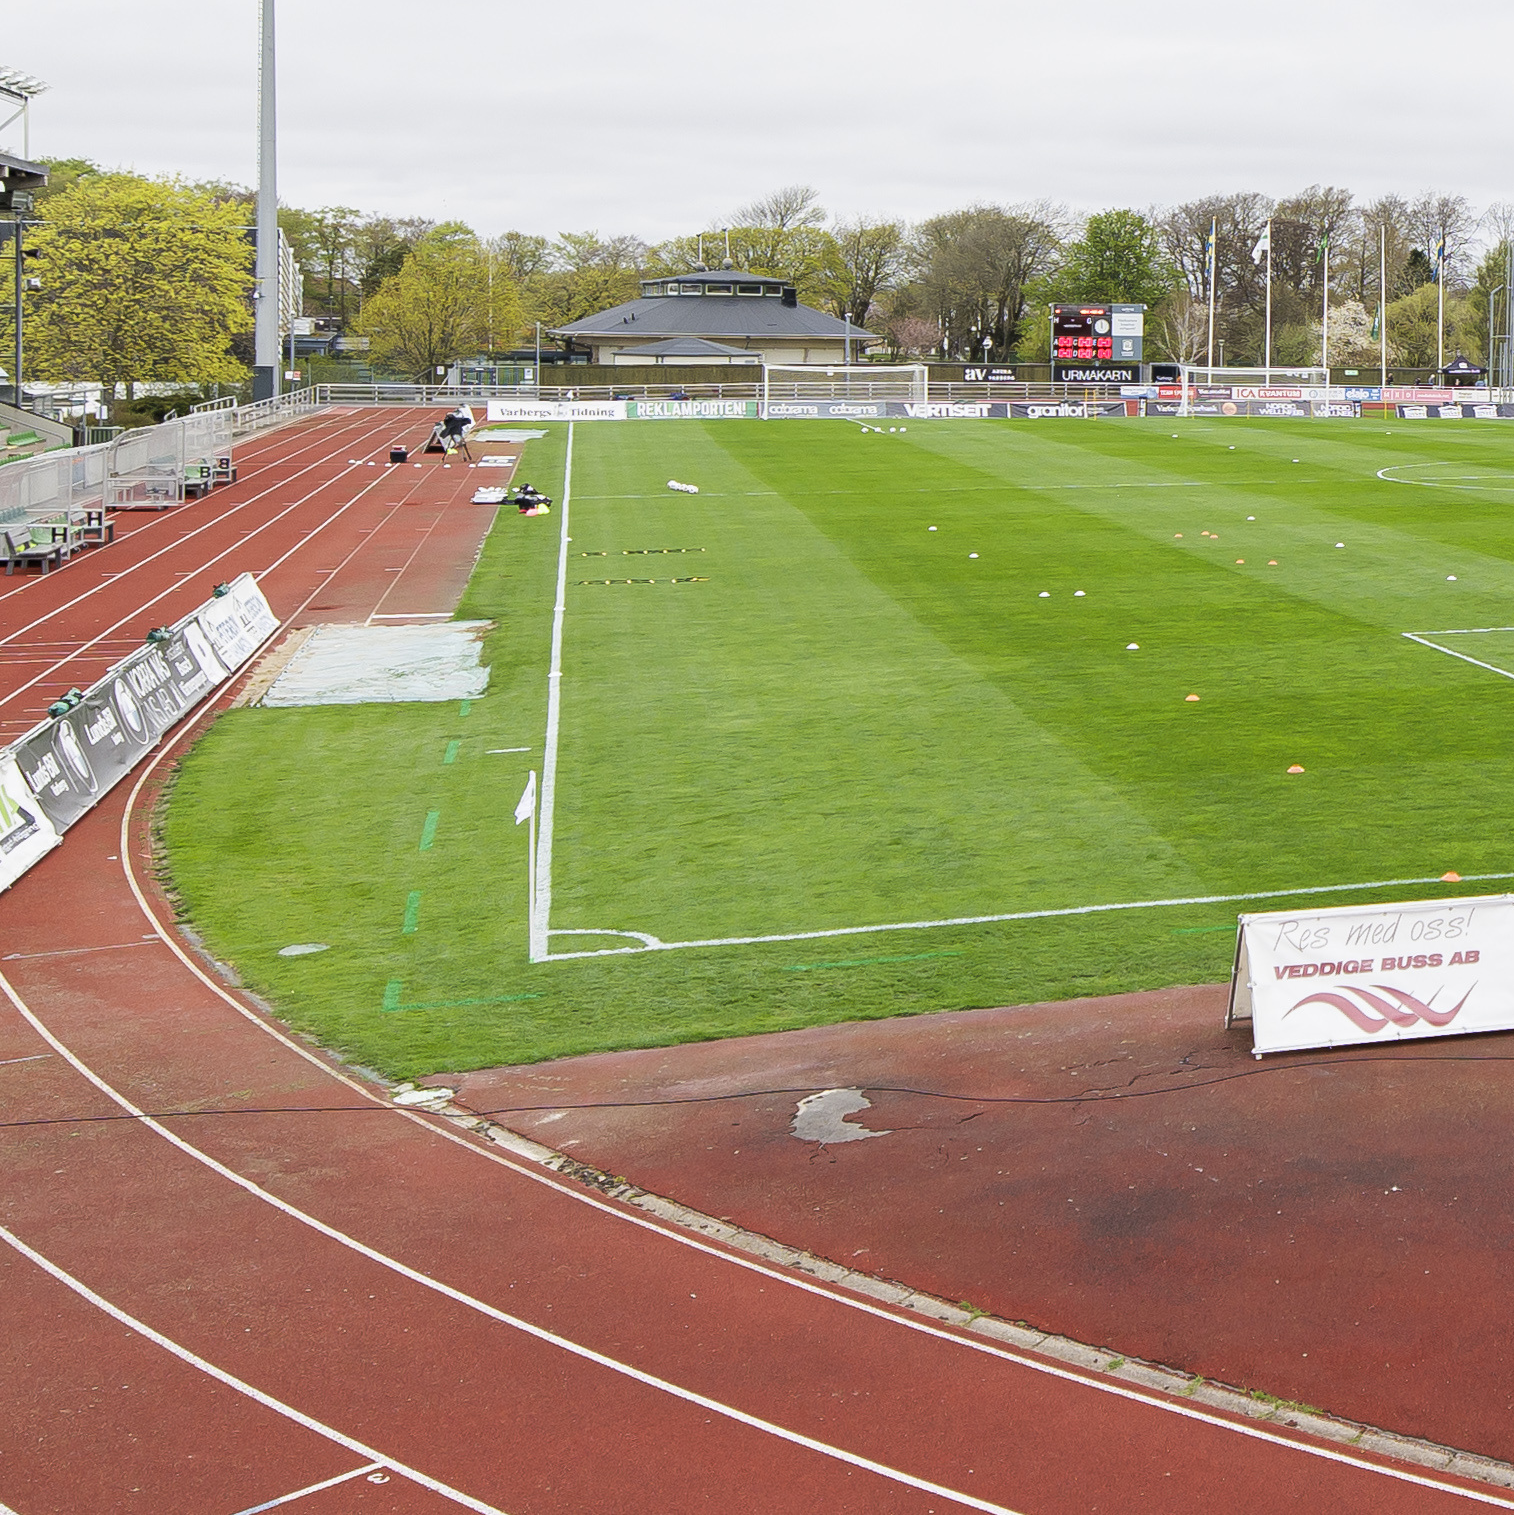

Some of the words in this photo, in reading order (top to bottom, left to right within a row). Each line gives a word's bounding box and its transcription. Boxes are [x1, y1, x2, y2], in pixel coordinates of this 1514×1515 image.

[499, 407, 552, 418] Varbergs
[570, 407, 615, 418] Tidning
[637, 401, 747, 417] REKLAMPORTEN!
[52, 526, 67, 543] H
[1274, 921, 1330, 952] Res
[1346, 913, 1402, 946] med
[1411, 907, 1475, 941] oss!
[1274, 959, 1374, 980] VEDDIGE
[1381, 954, 1443, 971] BUSS
[1448, 950, 1480, 966] AB
